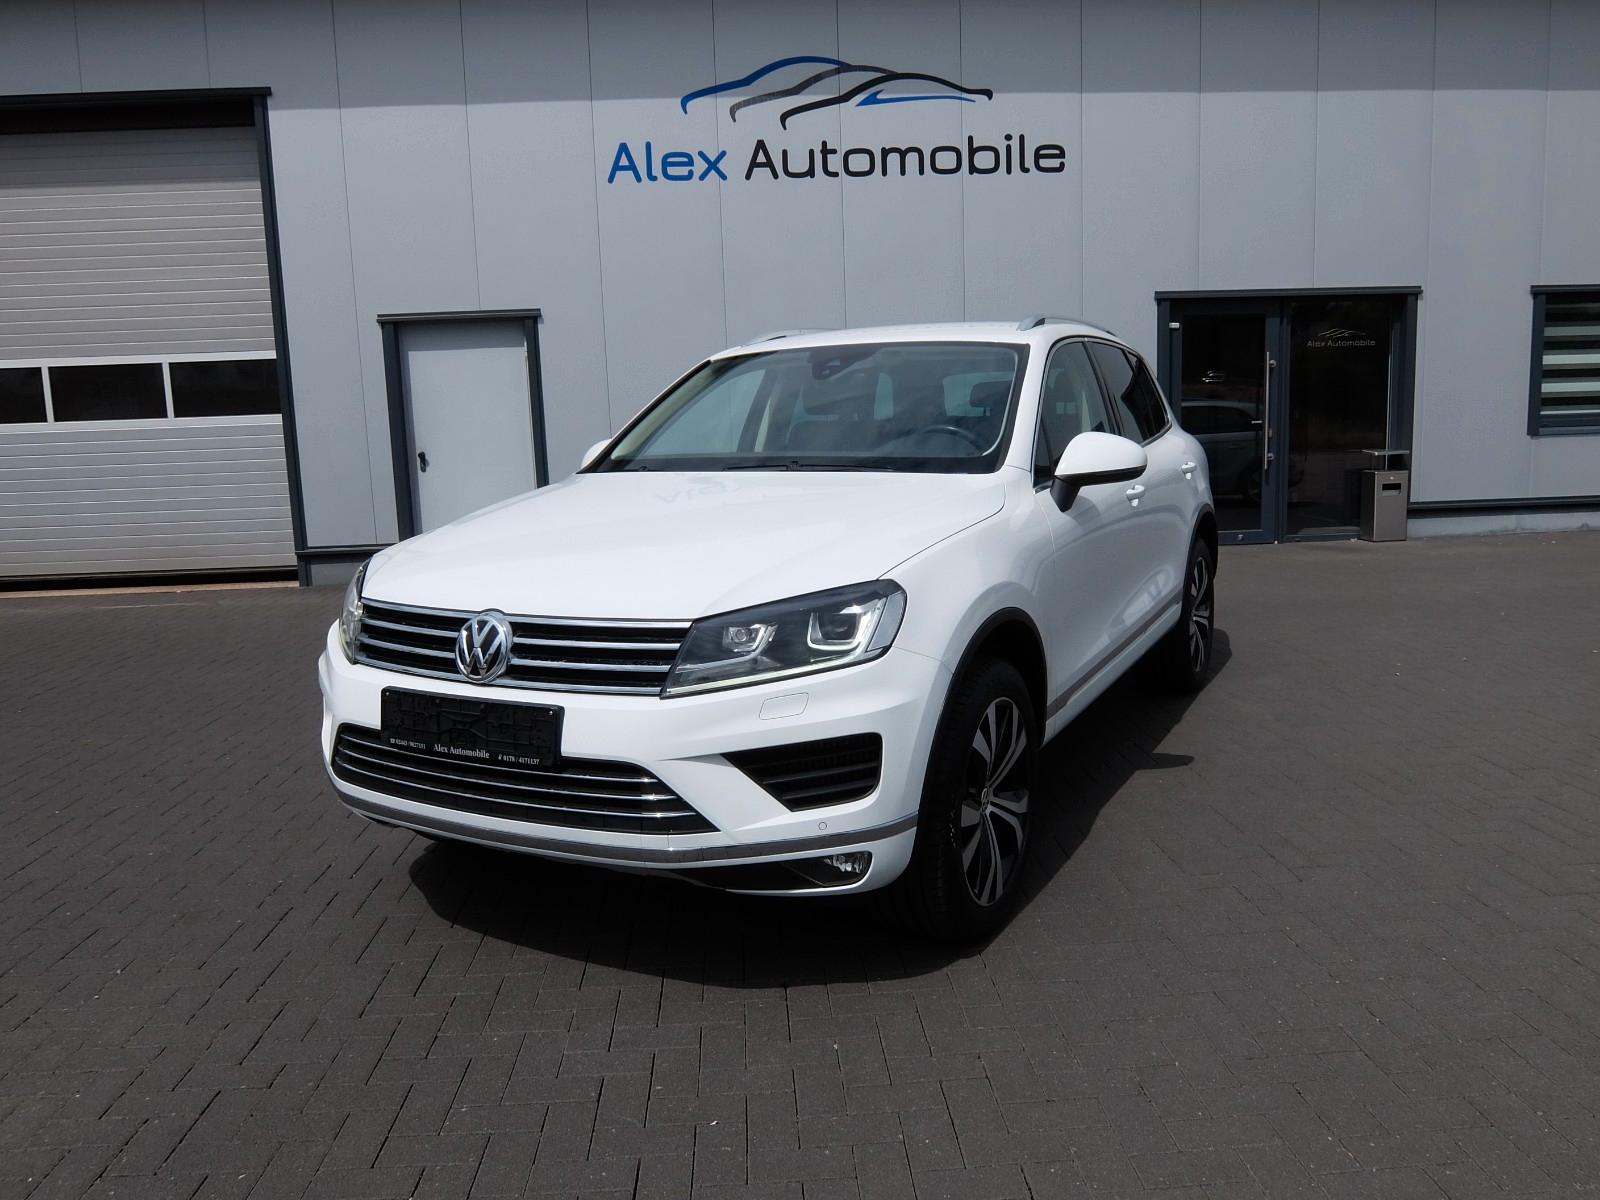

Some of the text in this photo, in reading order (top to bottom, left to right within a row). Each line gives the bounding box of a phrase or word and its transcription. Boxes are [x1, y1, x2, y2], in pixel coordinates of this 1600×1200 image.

[607, 133, 1067, 184] Alex Automobile
[1306, 339, 1376, 348] Alex Automobile
[433, 743, 490, 759] Alex Automobile
